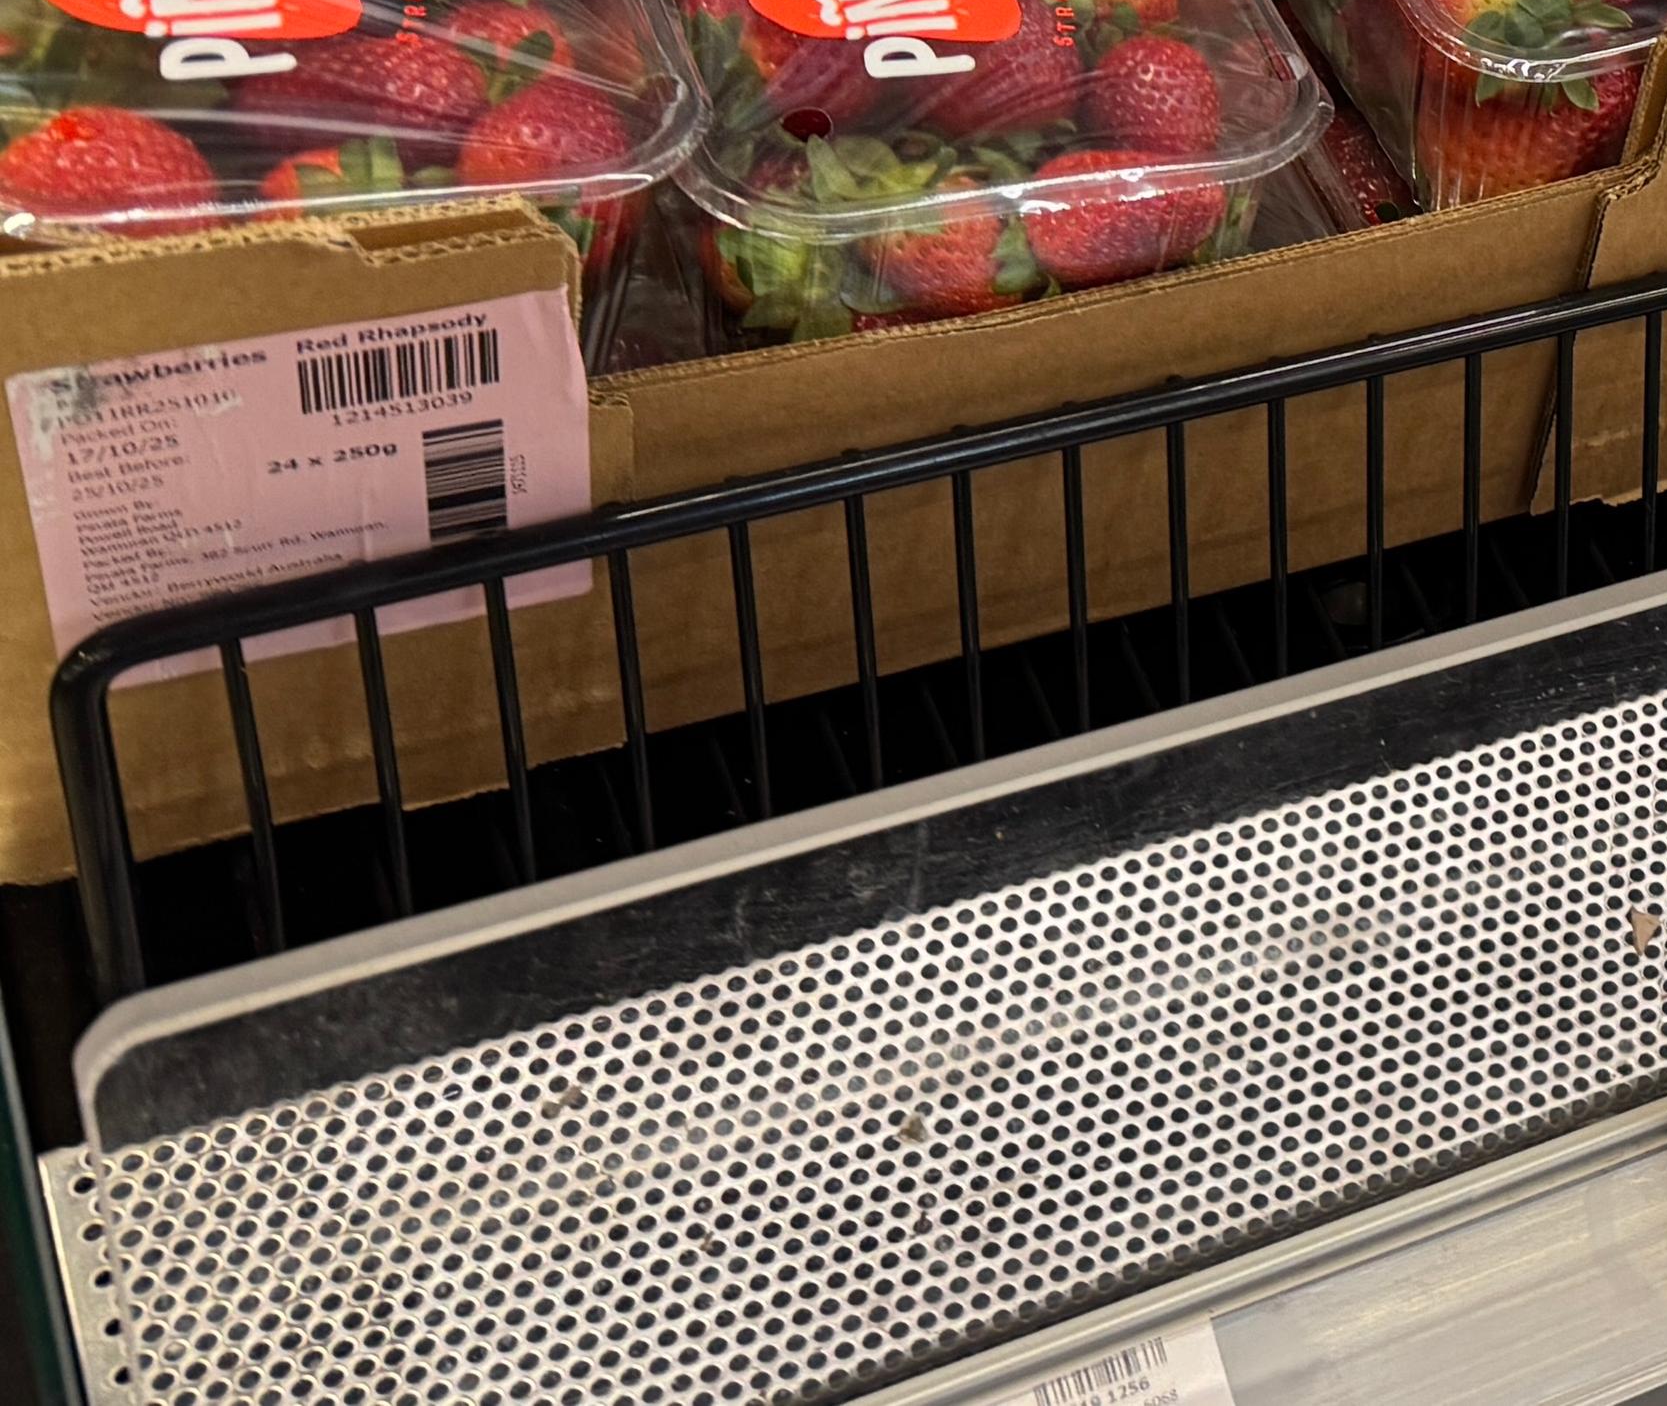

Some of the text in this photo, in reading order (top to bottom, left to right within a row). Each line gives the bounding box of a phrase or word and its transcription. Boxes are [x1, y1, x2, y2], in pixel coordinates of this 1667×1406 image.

[296, 334, 348, 354] Red
[359, 309, 488, 349] Rhapsody
[267, 457, 299, 476] 24
[334, 441, 399, 465] 250g
[1107, 1376, 1150, 1404] 1256
